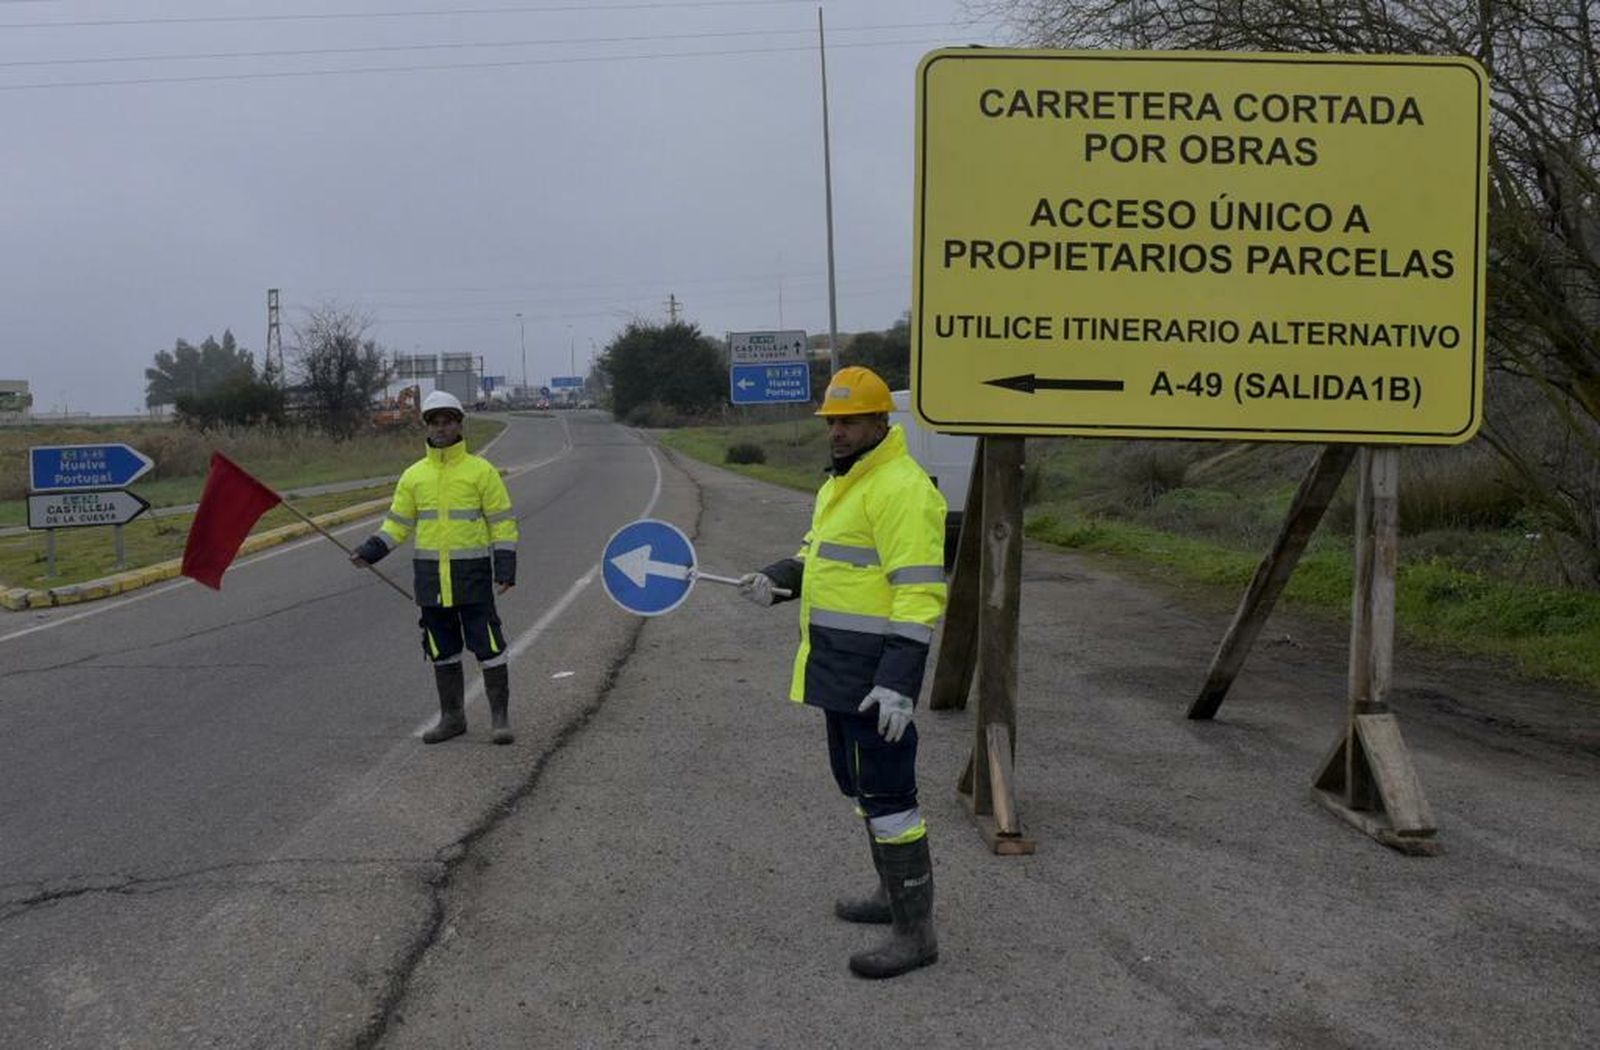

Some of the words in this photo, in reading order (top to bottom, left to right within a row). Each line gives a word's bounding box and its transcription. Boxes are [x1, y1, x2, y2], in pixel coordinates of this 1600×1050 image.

[979, 88, 1223, 122] CARRETERA
[1233, 92, 1425, 126] CORTADA
[1084, 132, 1168, 164] POR
[1179, 134, 1318, 167] OBRAS
[1029, 197, 1197, 231] ACCESO
[1209, 192, 1333, 234] ÚNICO
[1342, 204, 1371, 234] A
[943, 239, 1233, 275] PROPIETARIOS
[1246, 244, 1455, 280] PARCELAS
[935, 314, 1053, 341] UTILICE
[1063, 316, 1240, 345] ITINERARIO
[1247, 320, 1461, 350] ALTERNATIVO
[1148, 370, 1223, 398] A-49
[1233, 372, 1423, 410] (SALIDA1B)
[54, 472, 113, 485] Portugal
[60, 459, 107, 471] Huelva
[47, 503, 115, 515] CASTILLEJA
